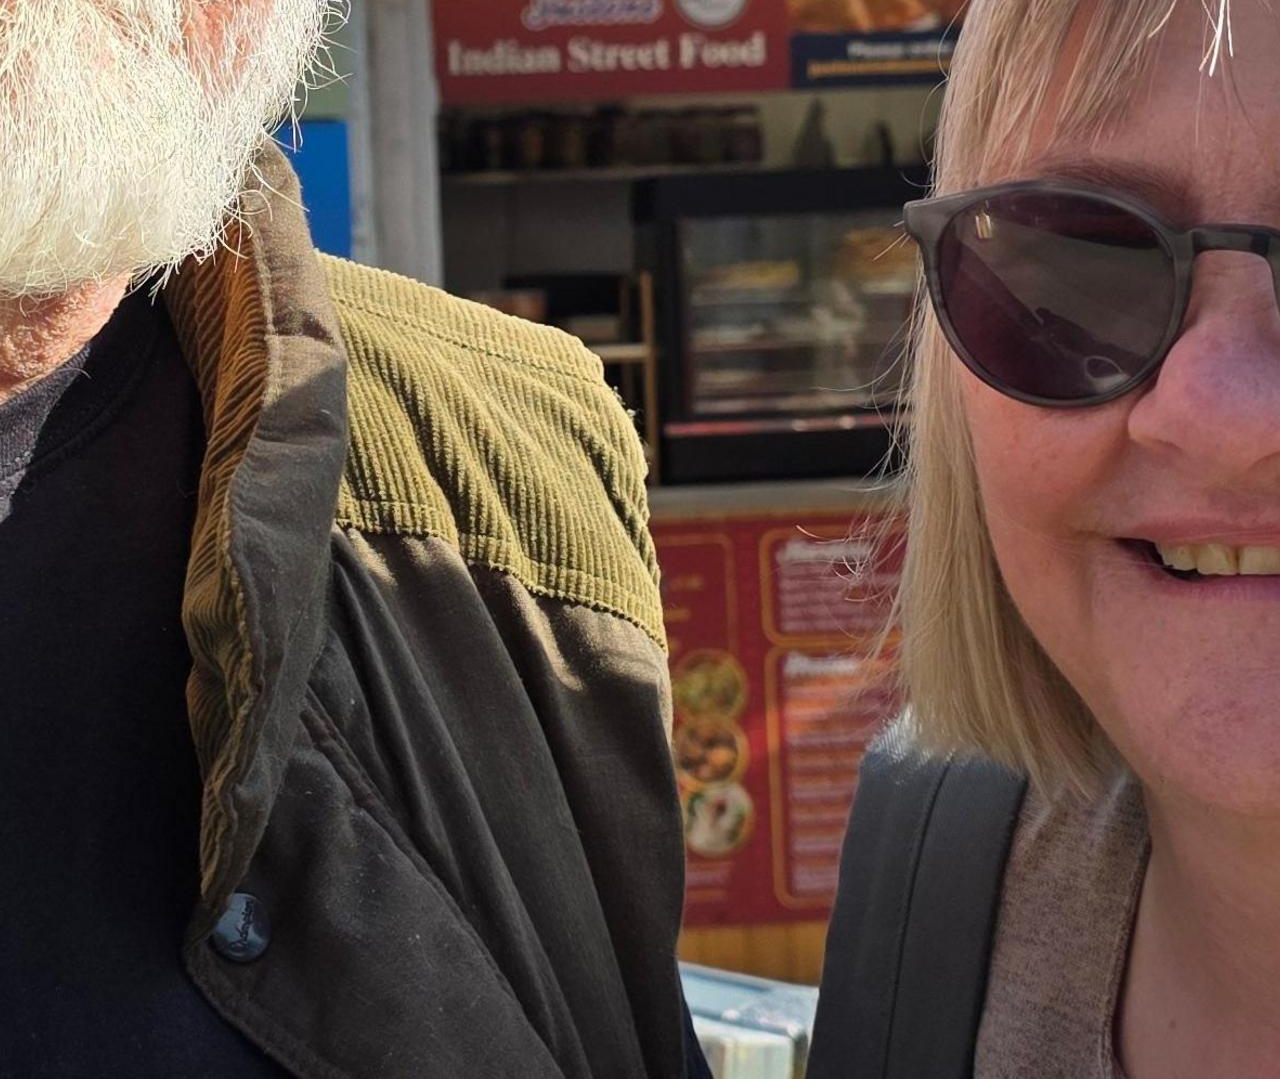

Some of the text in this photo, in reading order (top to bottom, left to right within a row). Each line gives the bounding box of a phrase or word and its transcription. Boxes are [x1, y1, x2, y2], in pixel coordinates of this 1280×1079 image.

[448, 38, 561, 76] Indian
[568, 35, 670, 71] Street
[679, 30, 766, 69] Food
